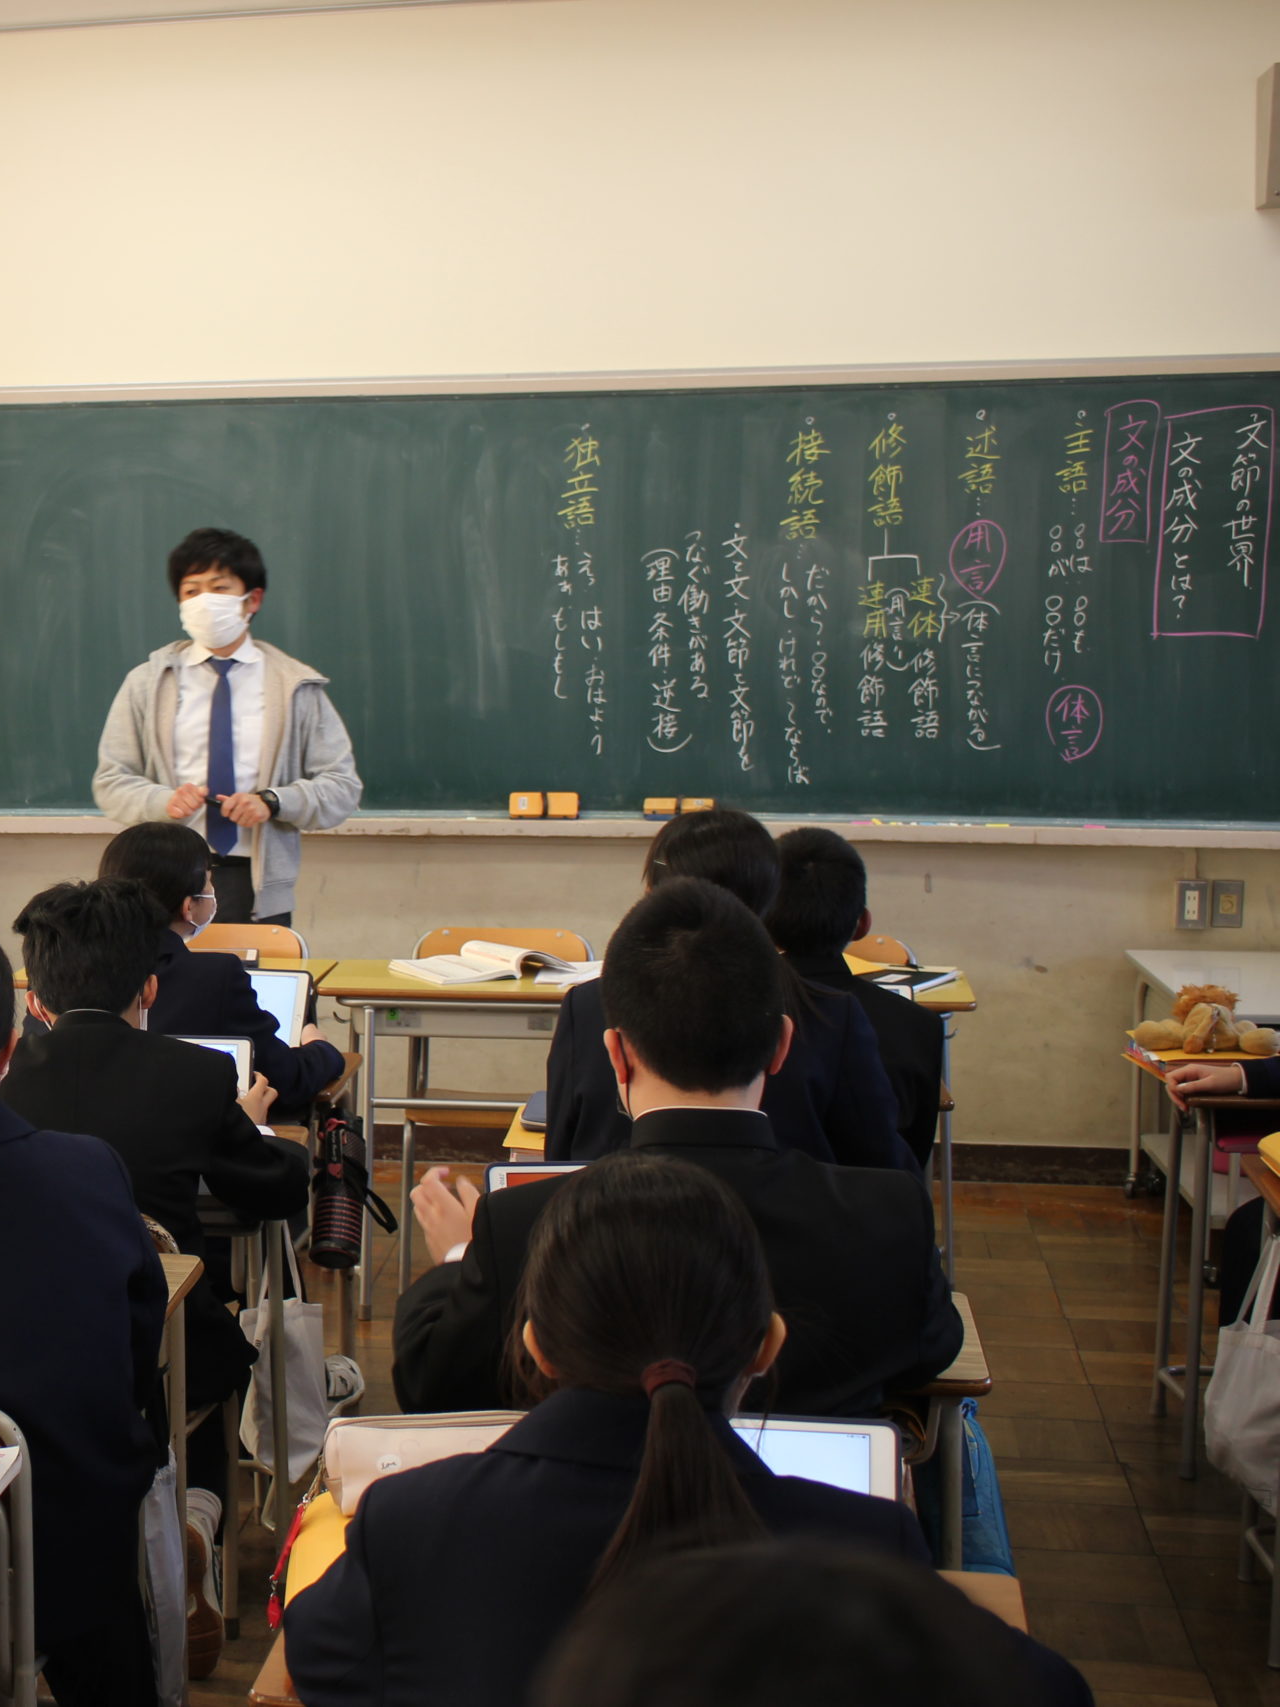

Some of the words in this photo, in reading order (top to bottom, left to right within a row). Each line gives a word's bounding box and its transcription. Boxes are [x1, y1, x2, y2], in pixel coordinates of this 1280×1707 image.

[557, 435, 601, 530] 独立語
[779, 429, 832, 541] 接続語
[867, 422, 907, 527] 修飾語
[1055, 422, 1094, 494] 主語
[1105, 414, 1150, 535] 文の成分
[1223, 413, 1269, 587] 文節の世界
[960, 521, 992, 592] 用言
[552, 606, 569, 700] もしもし
[677, 530, 712, 699] つなぐ働きがある
[856, 578, 888, 739] 連用修飾語
[908, 575, 942, 740] 連体修飾語
[1055, 693, 1091, 763] 体言
